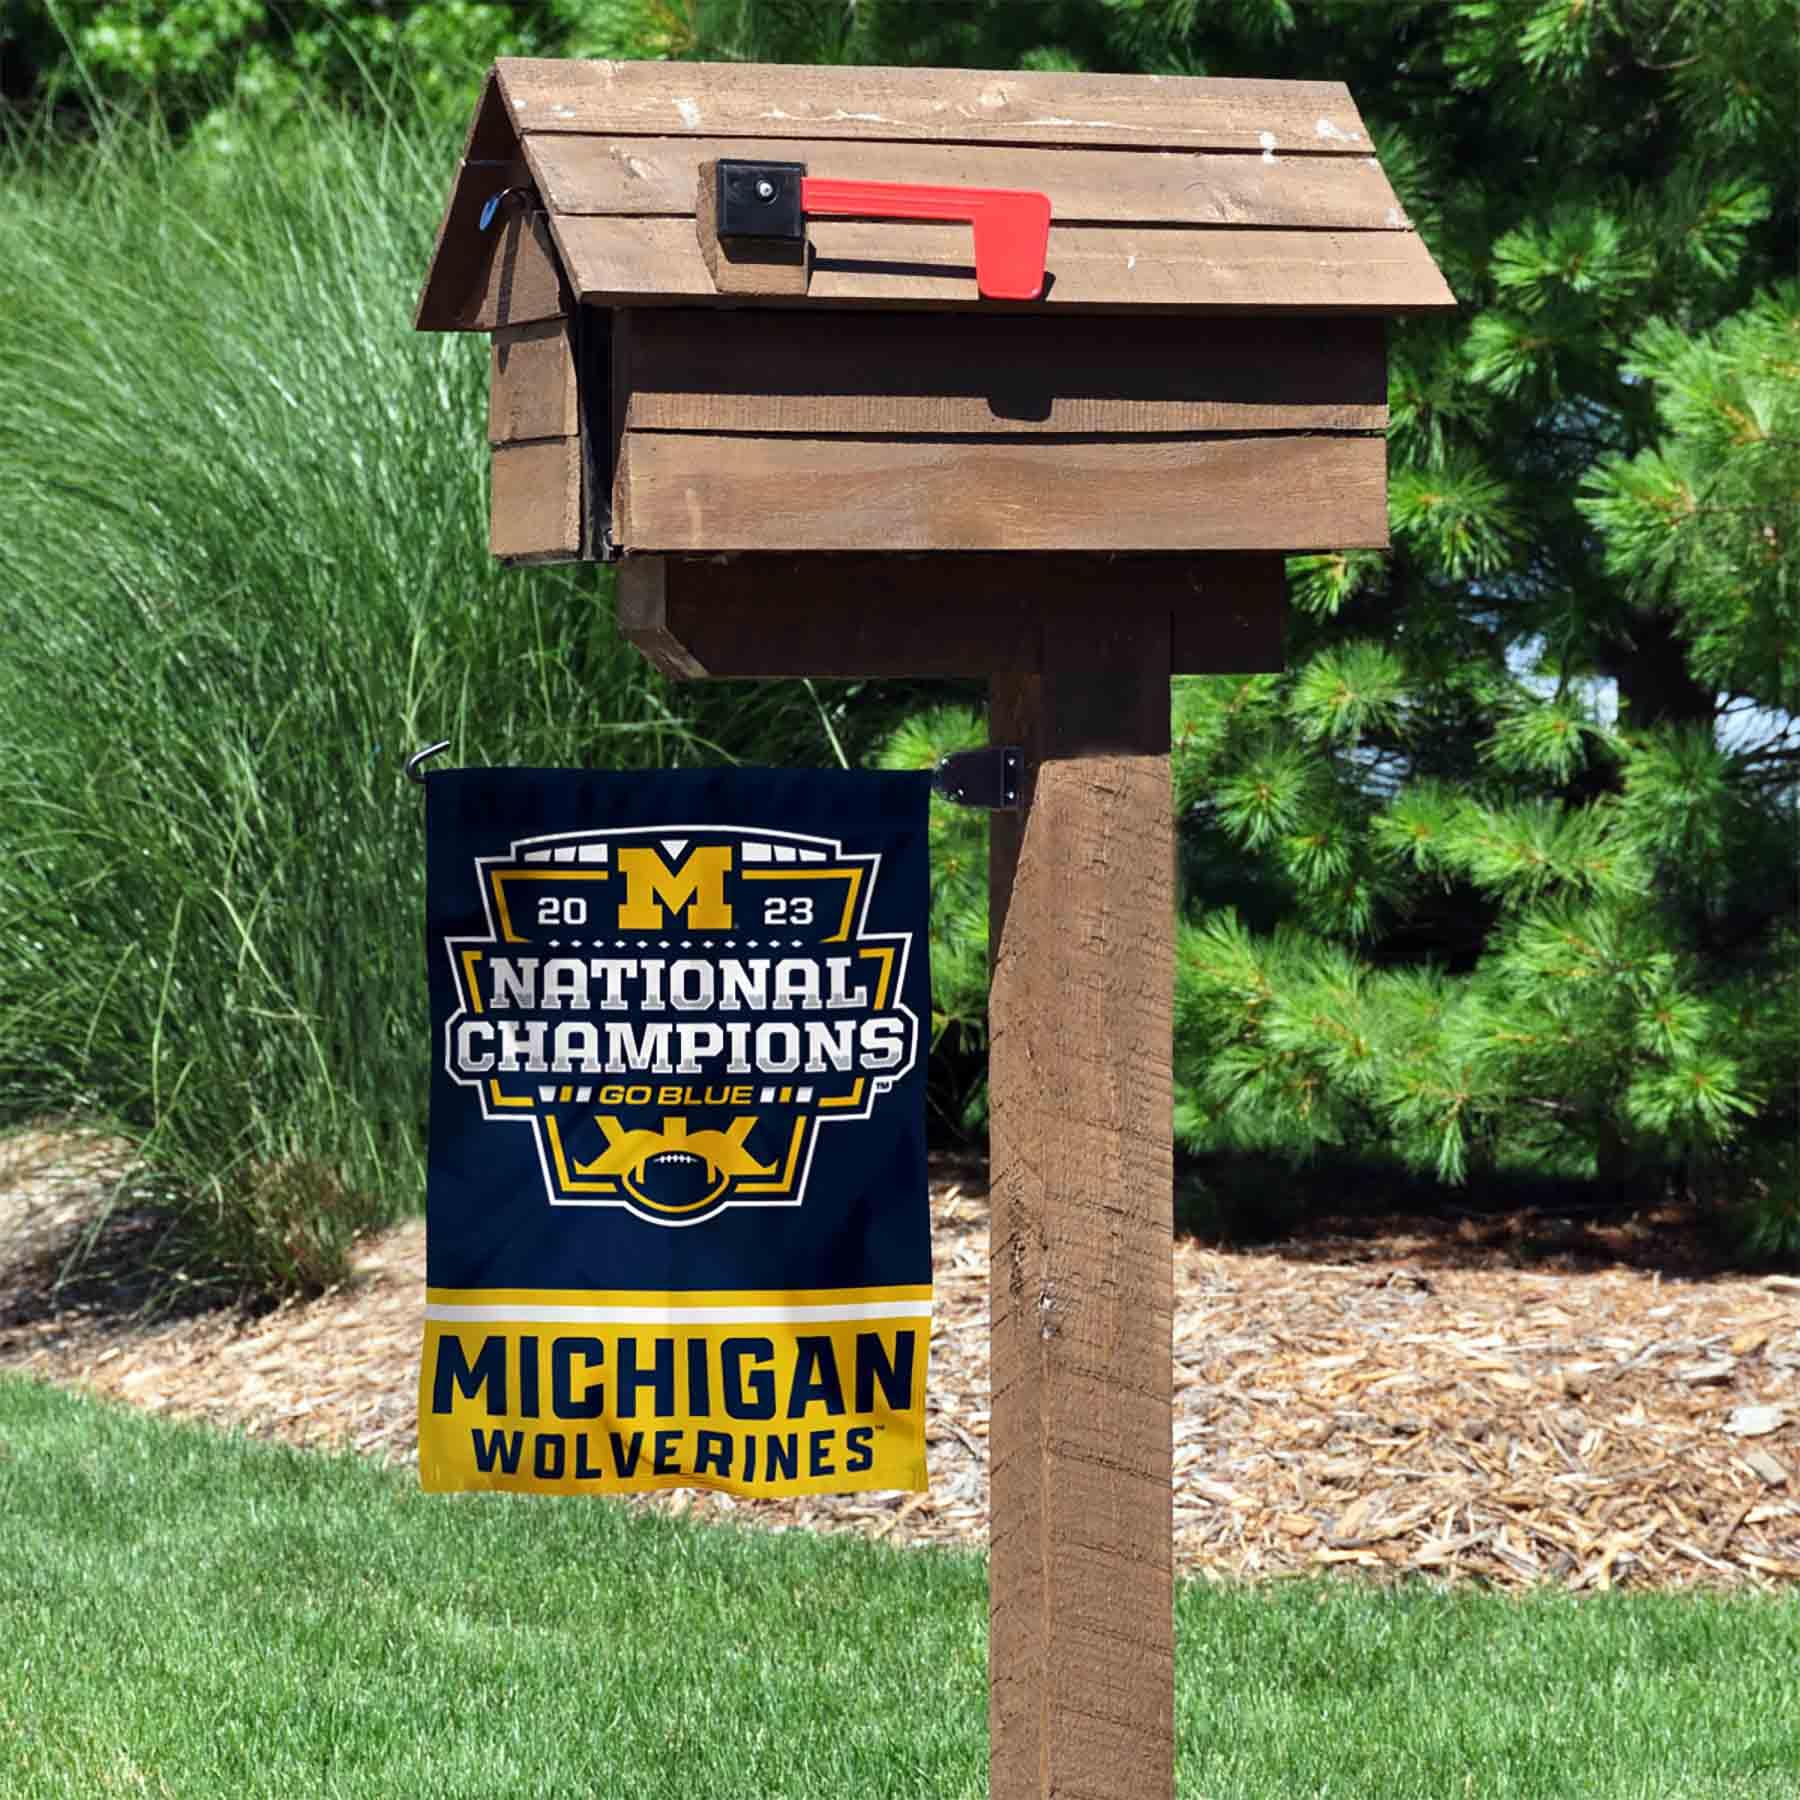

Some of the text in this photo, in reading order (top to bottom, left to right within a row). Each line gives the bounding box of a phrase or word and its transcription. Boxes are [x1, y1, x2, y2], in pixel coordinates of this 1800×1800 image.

[537, 896, 814, 925] 20 23
[617, 845, 733, 930] M
[489, 957, 867, 1010] NATIONAL
[457, 1018, 903, 1074] CHAMPIONS
[598, 1085, 753, 1105] GO BLUE
[432, 1330, 915, 1420] MICHIGAN
[472, 1426, 873, 1483] WOLVERINES
